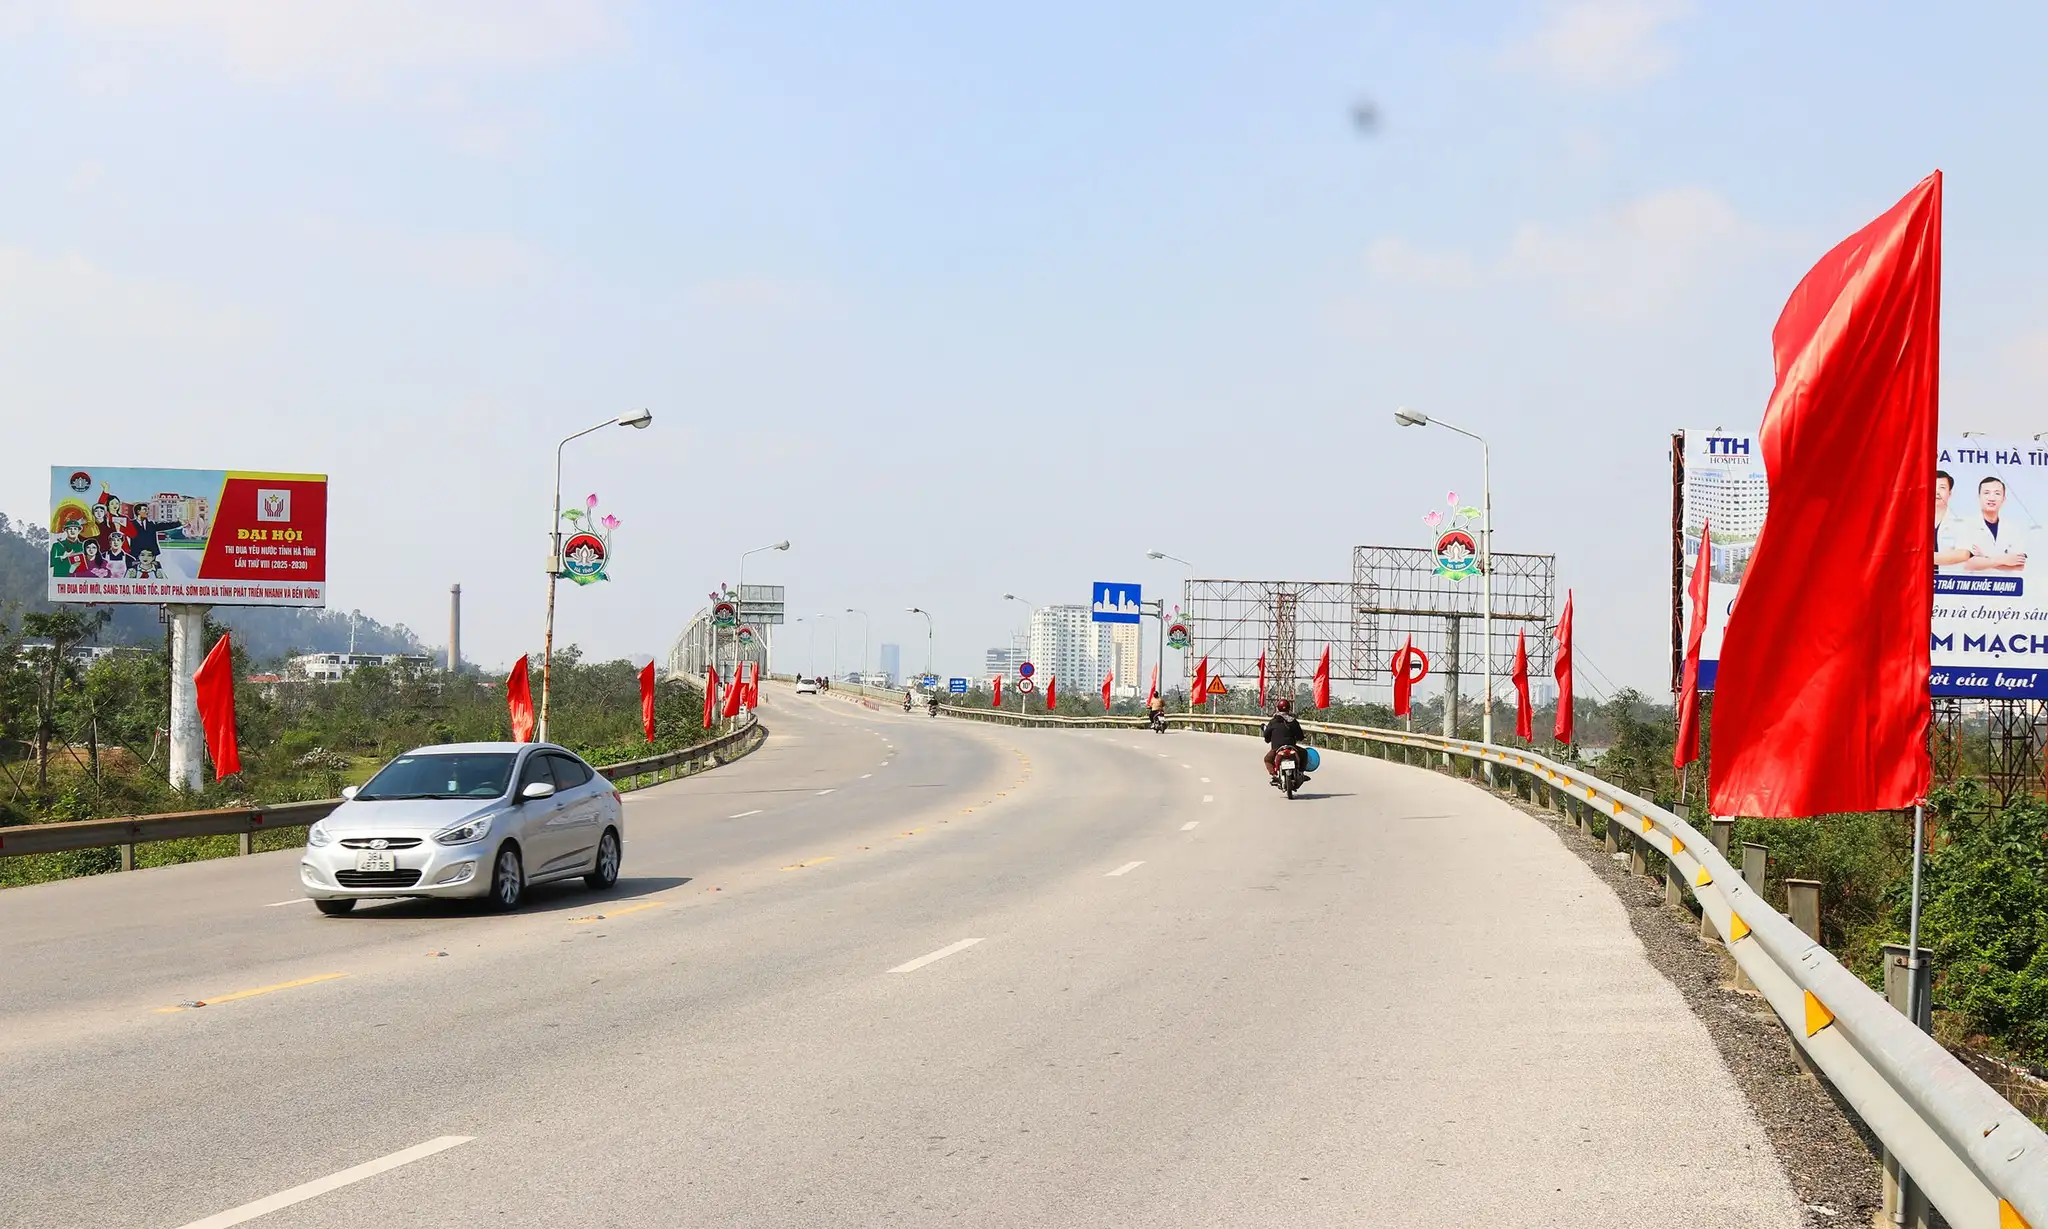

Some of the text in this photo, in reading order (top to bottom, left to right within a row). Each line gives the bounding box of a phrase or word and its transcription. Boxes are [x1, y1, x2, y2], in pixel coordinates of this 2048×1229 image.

[1706, 438, 1749, 454] TTH
[1710, 457, 1750, 465] HOSPITAL
[1957, 450, 1988, 464] TTH
[1996, 447, 2022, 465] HÀ
[237, 528, 303, 543] ĐẠI HỘI
[225, 545, 234, 554] THI
[236, 546, 247, 554] ĐUA
[249, 545, 260, 555] YÊU
[293, 546, 301, 555] HÀ
[57, 584, 66, 594] THI
[67, 584, 78, 594] ĐUA
[1937, 579, 1956, 590] TRÁI
[1956, 580, 1971, 590] TIM
[1992, 581, 2017, 593] MẠNH
[1952, 606, 1967, 619] và
[1971, 605, 2020, 624] chuyên
[2023, 607, 2048, 620] sâu
[1931, 632, 2048, 658] M MẠCH
[1955, 672, 1989, 687] của
[1994, 672, 2038, 690] bạn!
